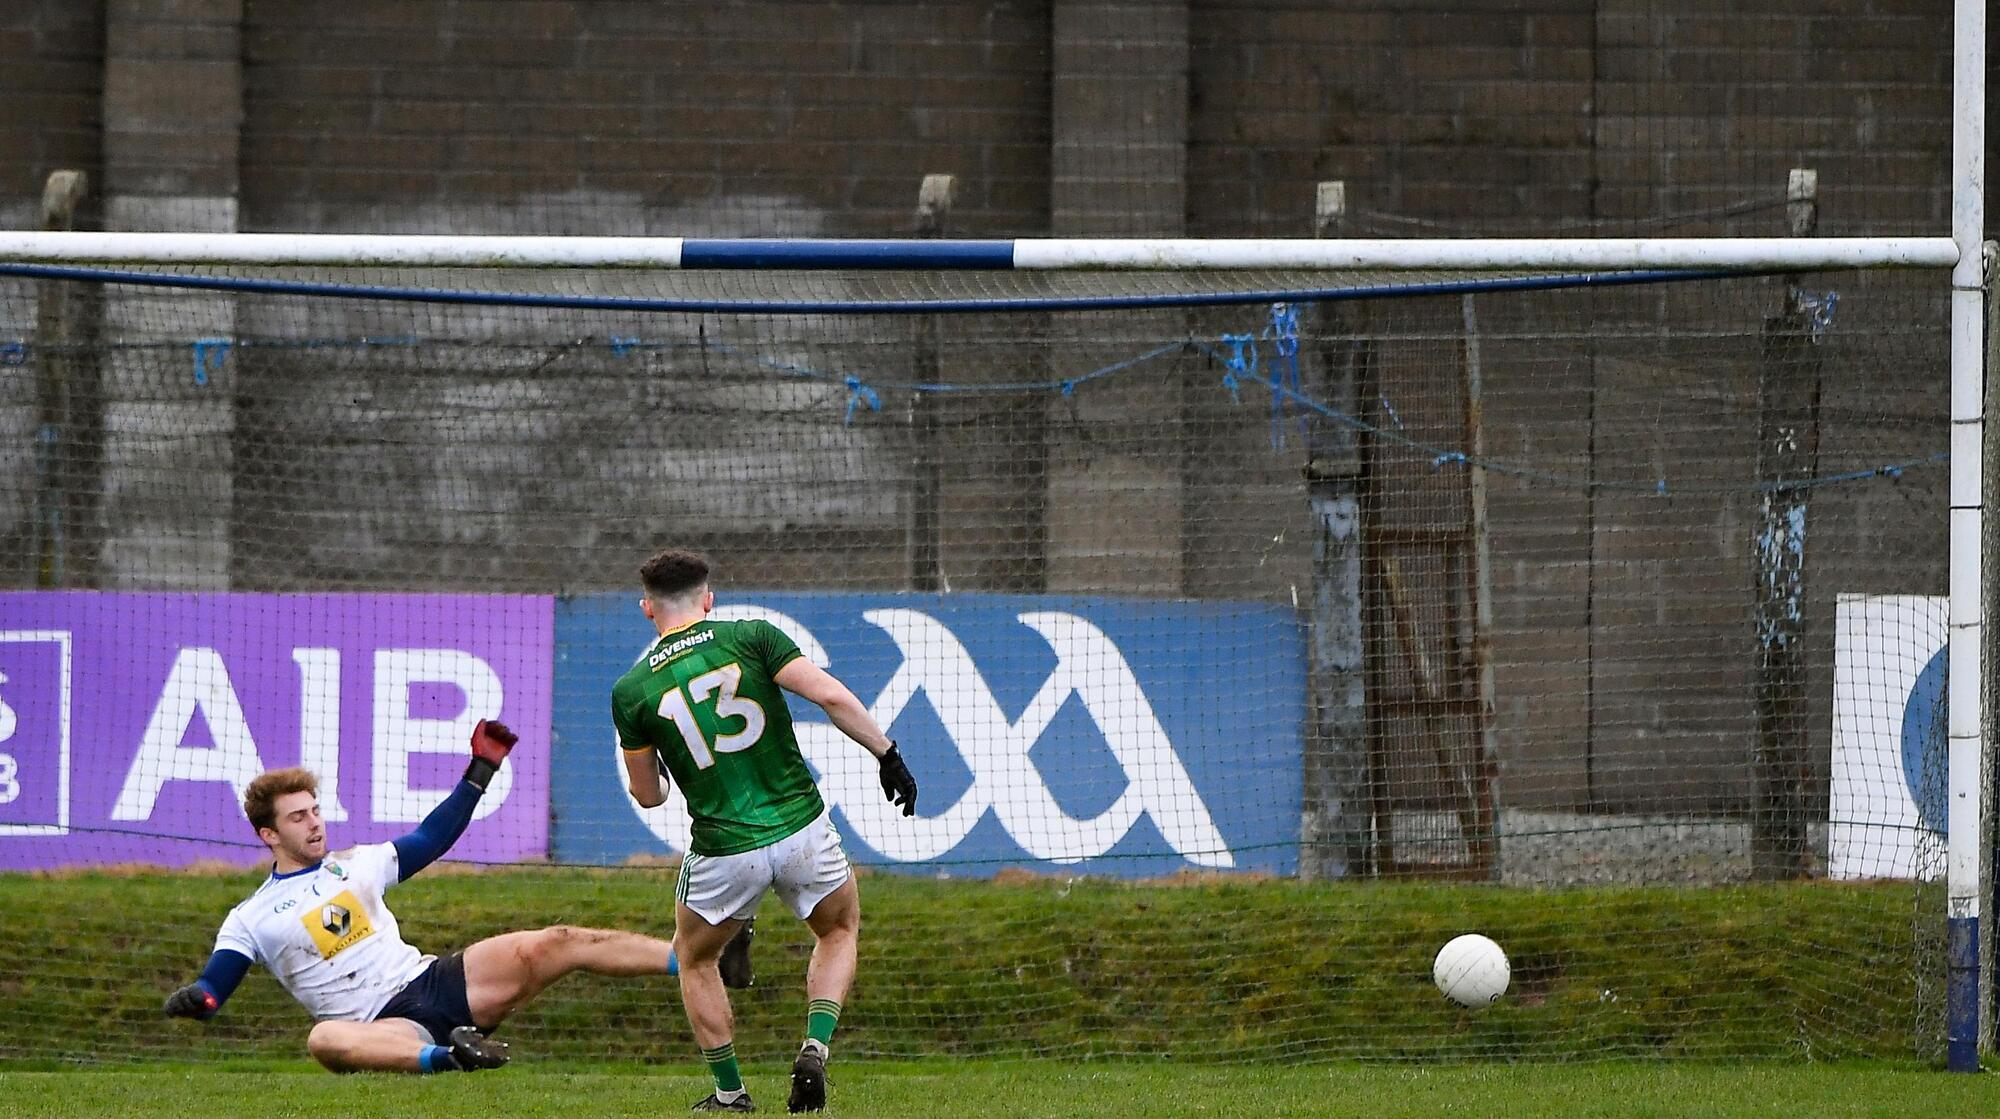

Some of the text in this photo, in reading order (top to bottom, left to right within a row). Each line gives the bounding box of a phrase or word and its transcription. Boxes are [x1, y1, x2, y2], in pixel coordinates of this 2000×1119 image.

[649, 629, 715, 668] DEVENISH
[111, 646, 514, 823] AIB
[657, 662, 767, 771] 13
